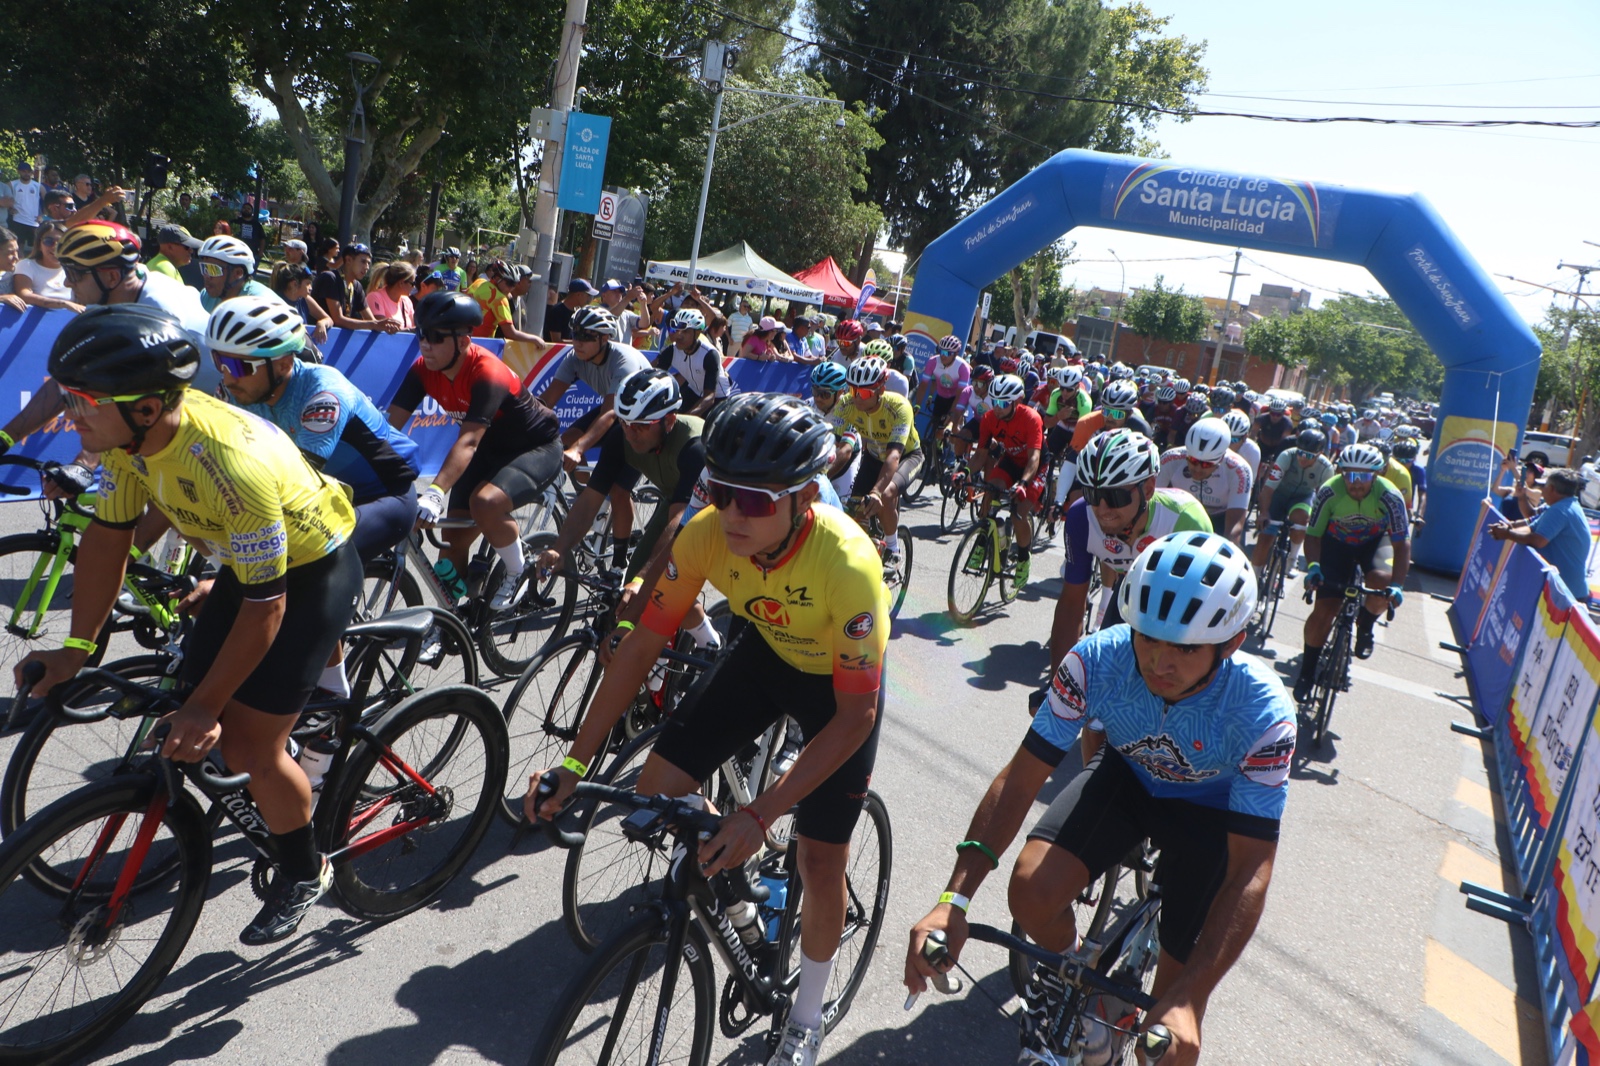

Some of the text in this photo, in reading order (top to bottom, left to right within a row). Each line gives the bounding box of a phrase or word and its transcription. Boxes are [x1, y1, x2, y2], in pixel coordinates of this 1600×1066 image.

[571, 144, 600, 156] PLAZA DE
[575, 153, 595, 162] SANTA
[1177, 169, 1269, 193] Ciudad de
[1140, 179, 1214, 212] Santa
[1169, 210, 1265, 235] Municipalidad
[670, 267, 689, 279] ÁRE
[696, 273, 739, 286] DEPORTE
[565, 394, 594, 405] Ciudad
[407, 411, 450, 437] para
[1445, 455, 1498, 471] Santa Luca
[1457, 450, 1480, 459] Ciudad
[231, 530, 258, 541] Juan
[231, 531, 286, 555] Orrego
[237, 546, 286, 564] Intendente
